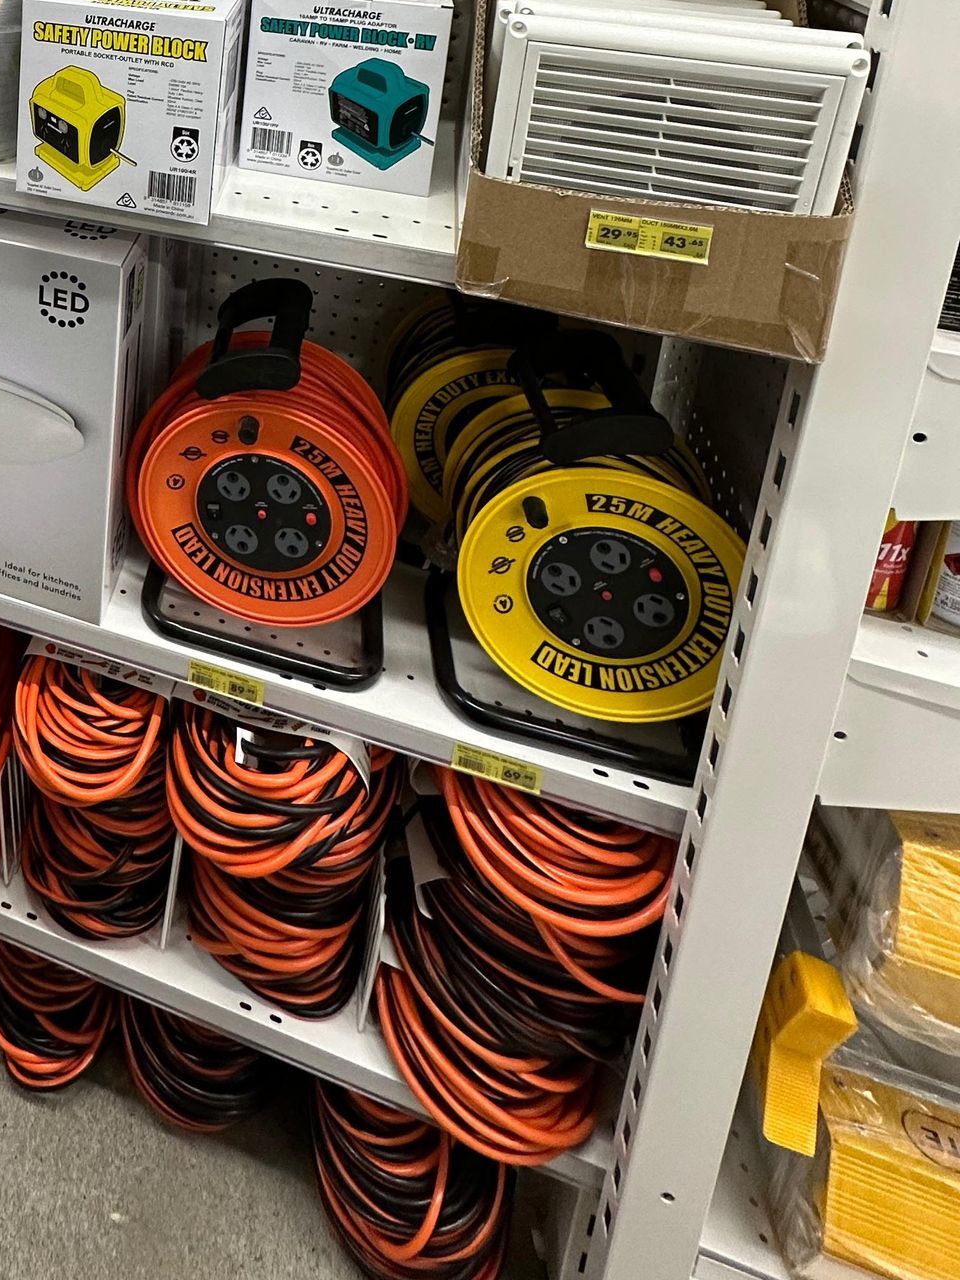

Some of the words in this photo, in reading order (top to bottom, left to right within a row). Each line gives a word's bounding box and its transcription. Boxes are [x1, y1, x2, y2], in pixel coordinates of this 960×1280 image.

[85, 14, 156, 32] ULTRACHARGE
[313, 6, 382, 21] ULTRACHARGE
[367, 21, 397, 29] ADAPTOR
[33, 21, 91, 47] SAFETY
[91, 27, 150, 56] POWER
[151, 37, 208, 63] BLOCK
[260, 17, 310, 36] SAFETY
[310, 21, 360, 41] POWER
[361, 26, 409, 48] BLOCK
[414, 34, 437, 51] RV
[332, 41, 349, 49] FARM
[353, 44, 380, 53] WELDING
[60, 48, 92, 58] PORTABLE
[93, 52, 144, 64] SOCKET-OUTLET
[144, 58, 159, 66] WITH
[600, 227, 638, 239] 29.95
[664, 236, 703, 248] 43.65
[39, 284, 90, 314] LED
[293, 439, 344, 479] 25M
[336, 484, 365, 538] HEAVY
[591, 495, 653, 522] 25M
[174, 526, 214, 569] LEAD
[657, 517, 718, 574] HEAVY
[4, 560, 26, 572] Ideal
[28, 566, 40, 579] for
[41, 571, 82, 593] kitchens,
[22, 575, 39, 587] and
[213, 564, 325, 601] EXTENSION
[325, 543, 362, 589] DUTY
[705, 582, 732, 638] DUTY
[537, 645, 593, 686] LEAD
[599, 639, 717, 692] EXTENSION
